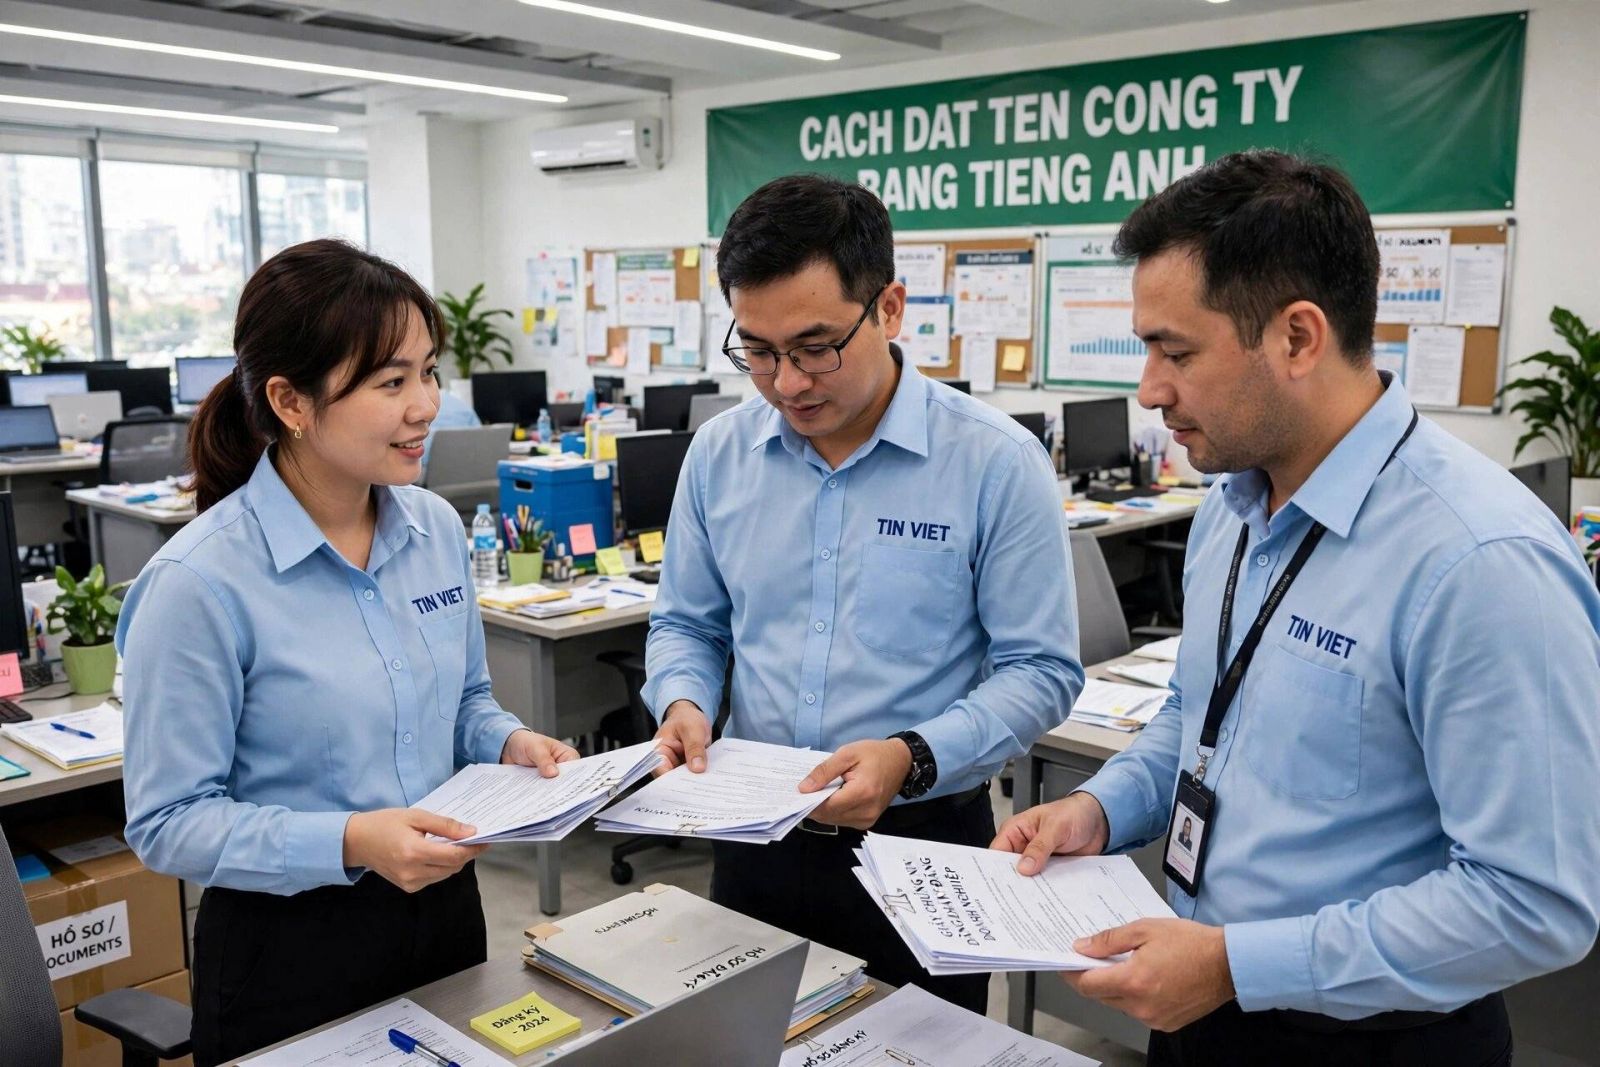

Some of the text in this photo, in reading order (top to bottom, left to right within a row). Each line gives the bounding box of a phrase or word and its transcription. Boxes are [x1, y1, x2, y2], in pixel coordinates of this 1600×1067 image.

[799, 65, 1304, 161] CACH DAT TEN CONG TY
[968, 153, 1092, 208] TIENG
[1103, 144, 1205, 202] ANH
[877, 518, 951, 542] TIN VIET
[411, 586, 464, 615] TIN VIET
[1287, 614, 1357, 659] TIN VIET
[51, 924, 76, 948] HỒ
[82, 920, 105, 939] SƠ
[46, 936, 123, 969] OCUMENTS
[518, 1015, 550, 1032] 2024
